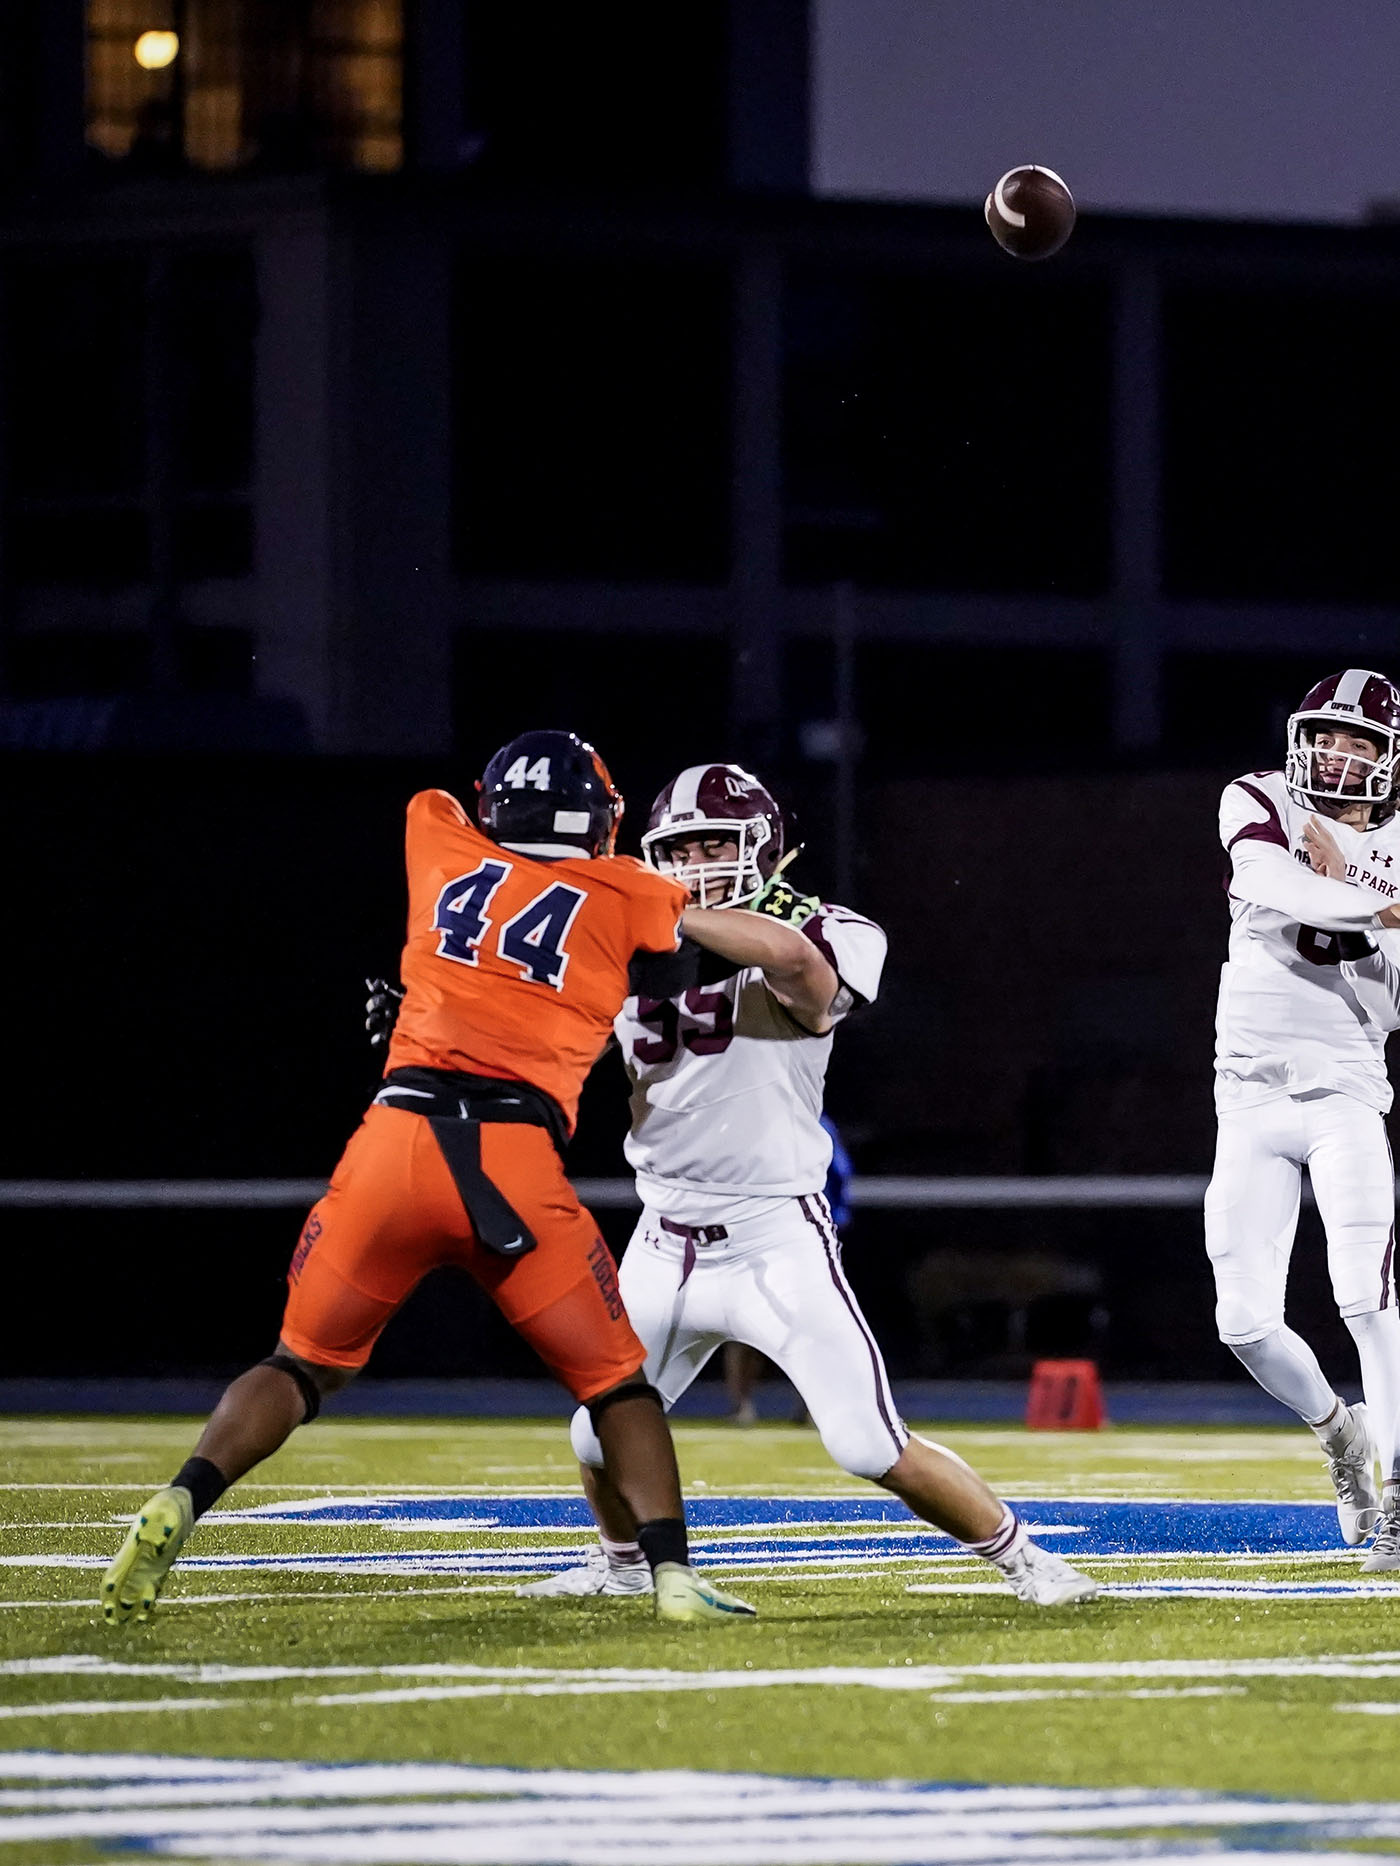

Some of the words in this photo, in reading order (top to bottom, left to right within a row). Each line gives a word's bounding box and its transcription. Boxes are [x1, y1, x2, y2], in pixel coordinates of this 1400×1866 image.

[503, 755, 551, 791] 44
[1359, 870, 1399, 899] PARK
[429, 857, 589, 994] 44
